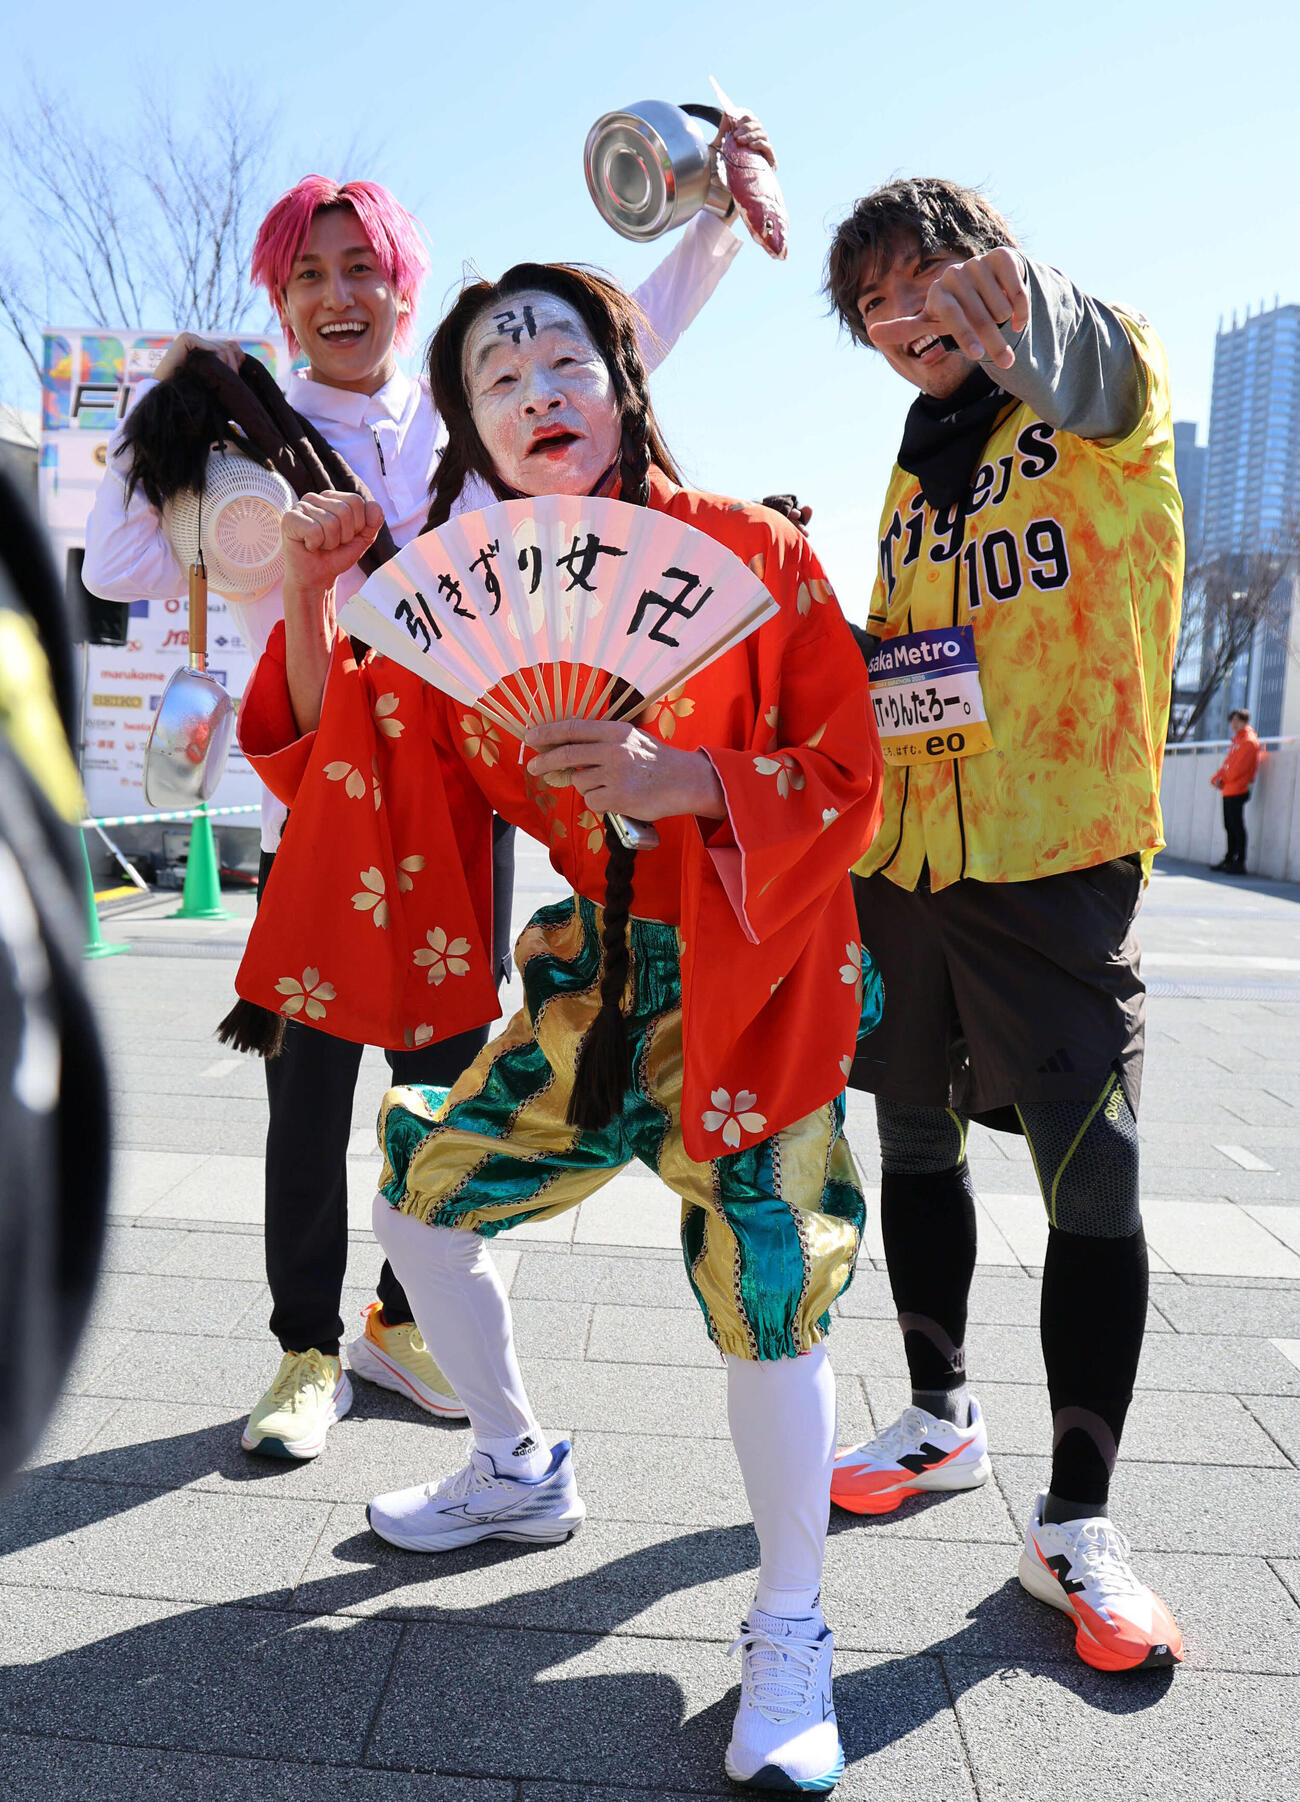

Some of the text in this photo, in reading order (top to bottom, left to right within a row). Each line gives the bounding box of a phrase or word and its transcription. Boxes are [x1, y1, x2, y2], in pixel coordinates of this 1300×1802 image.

[493, 305, 537, 344] 引
[878, 420, 1061, 607] Tigers
[963, 516, 1071, 610] 109
[394, 532, 628, 654] 引きずり女
[894, 640, 961, 668] Metro
[101, 668, 164, 681] marukome
[926, 732, 966, 756] eo
